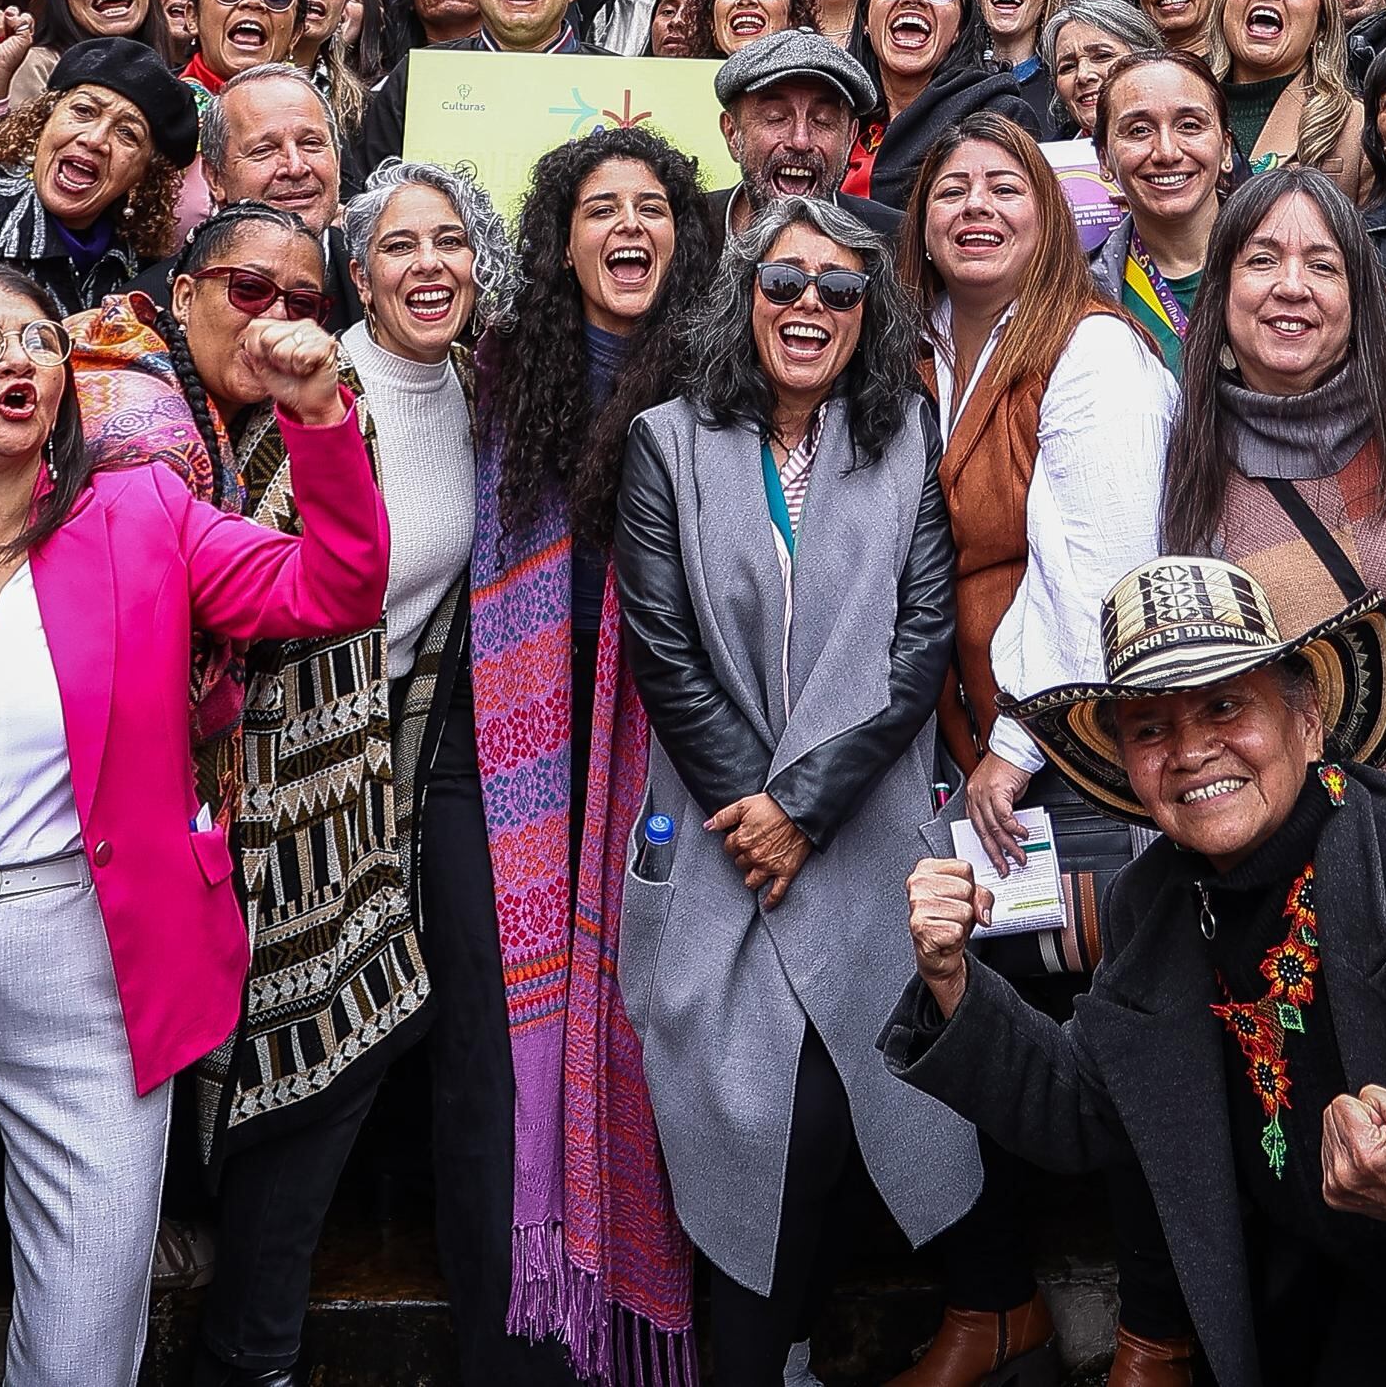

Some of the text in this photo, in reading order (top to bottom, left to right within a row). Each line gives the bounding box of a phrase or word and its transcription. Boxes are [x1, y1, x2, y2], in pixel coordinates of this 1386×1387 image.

[441, 100, 486, 111] Culturas
[1108, 626, 1272, 676] TIERRA Y DIGNIDAD
